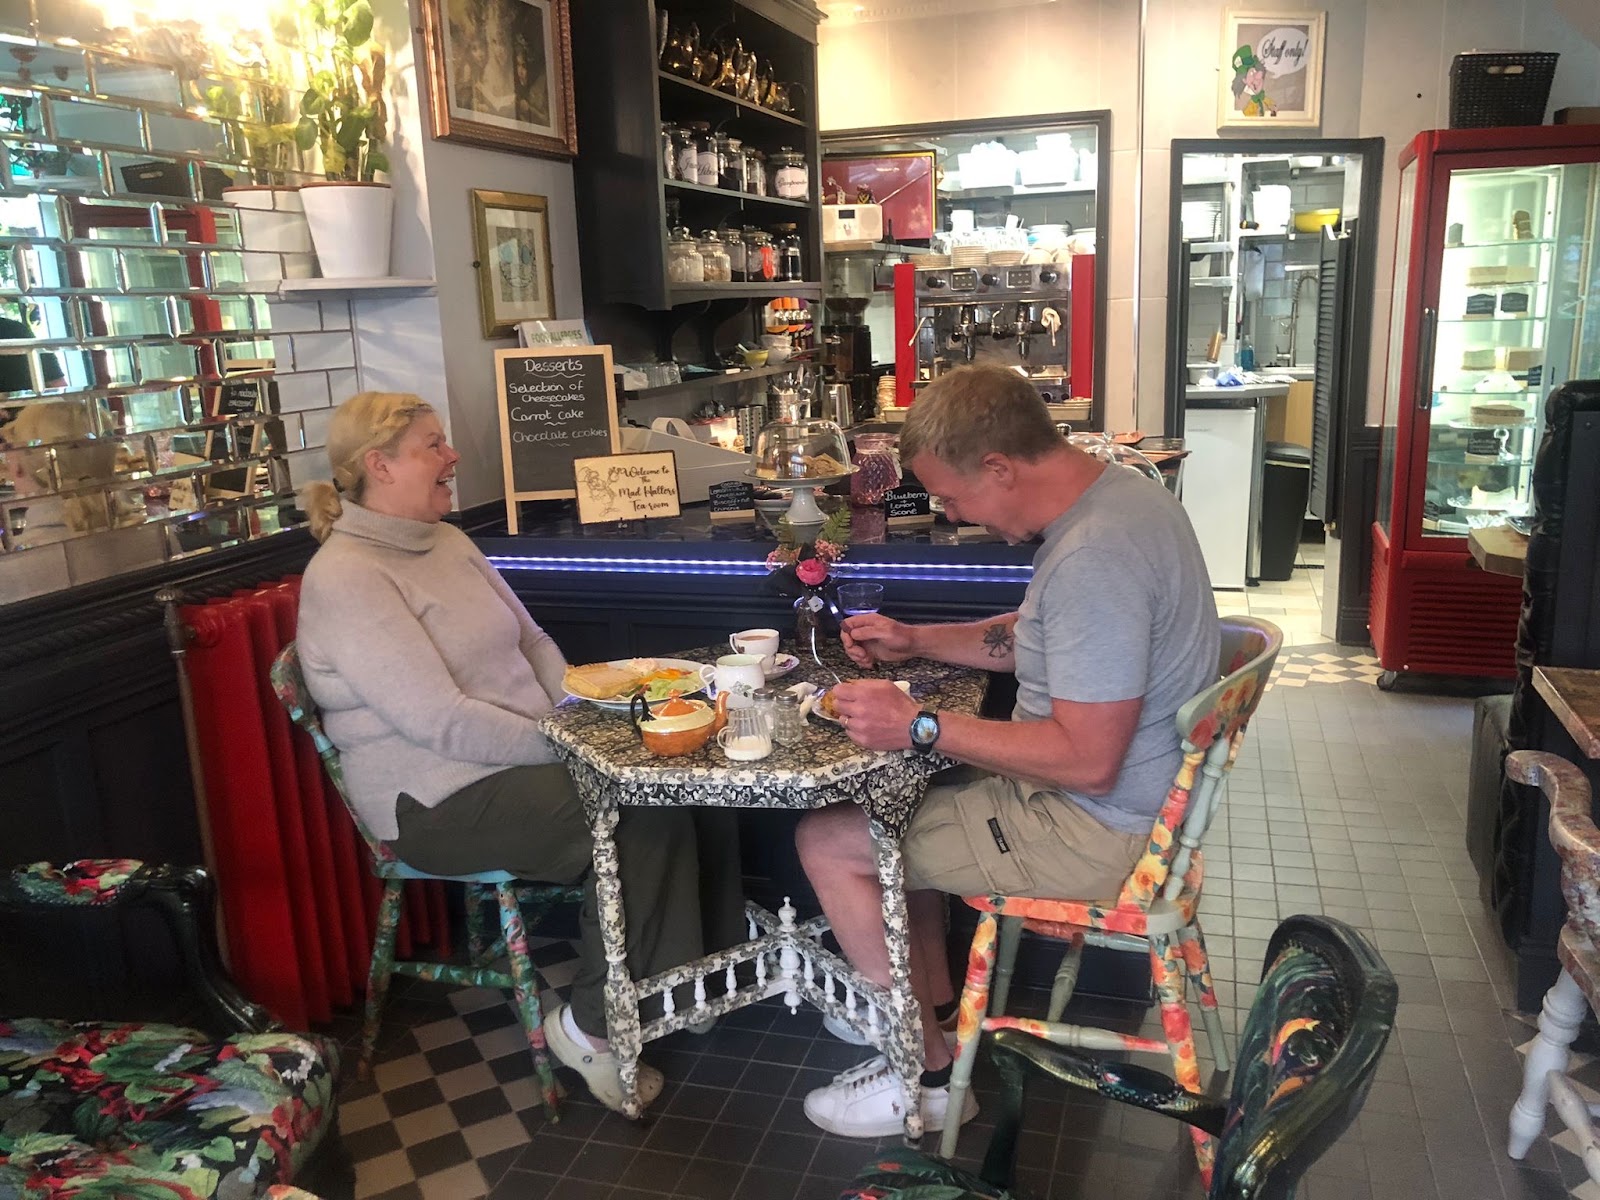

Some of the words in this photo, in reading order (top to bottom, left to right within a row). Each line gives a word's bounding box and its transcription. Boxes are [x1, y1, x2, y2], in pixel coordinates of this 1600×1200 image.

[523, 358, 583, 372] Desserts
[509, 381, 564, 394] Selection
[569, 380, 584, 391] of
[521, 393, 585, 403] Cheesecakes
[511, 407, 552, 422] Carrot
[512, 431, 569, 443] Chocolate
[571, 428, 608, 439] cookies
[622, 466, 660, 478] Welcome
[661, 465, 670, 474] to
[618, 486, 641, 498] Mad
[643, 485, 676, 498] Hatters
[884, 490, 929, 502] Blueberry
[889, 501, 916, 509] Lemon
